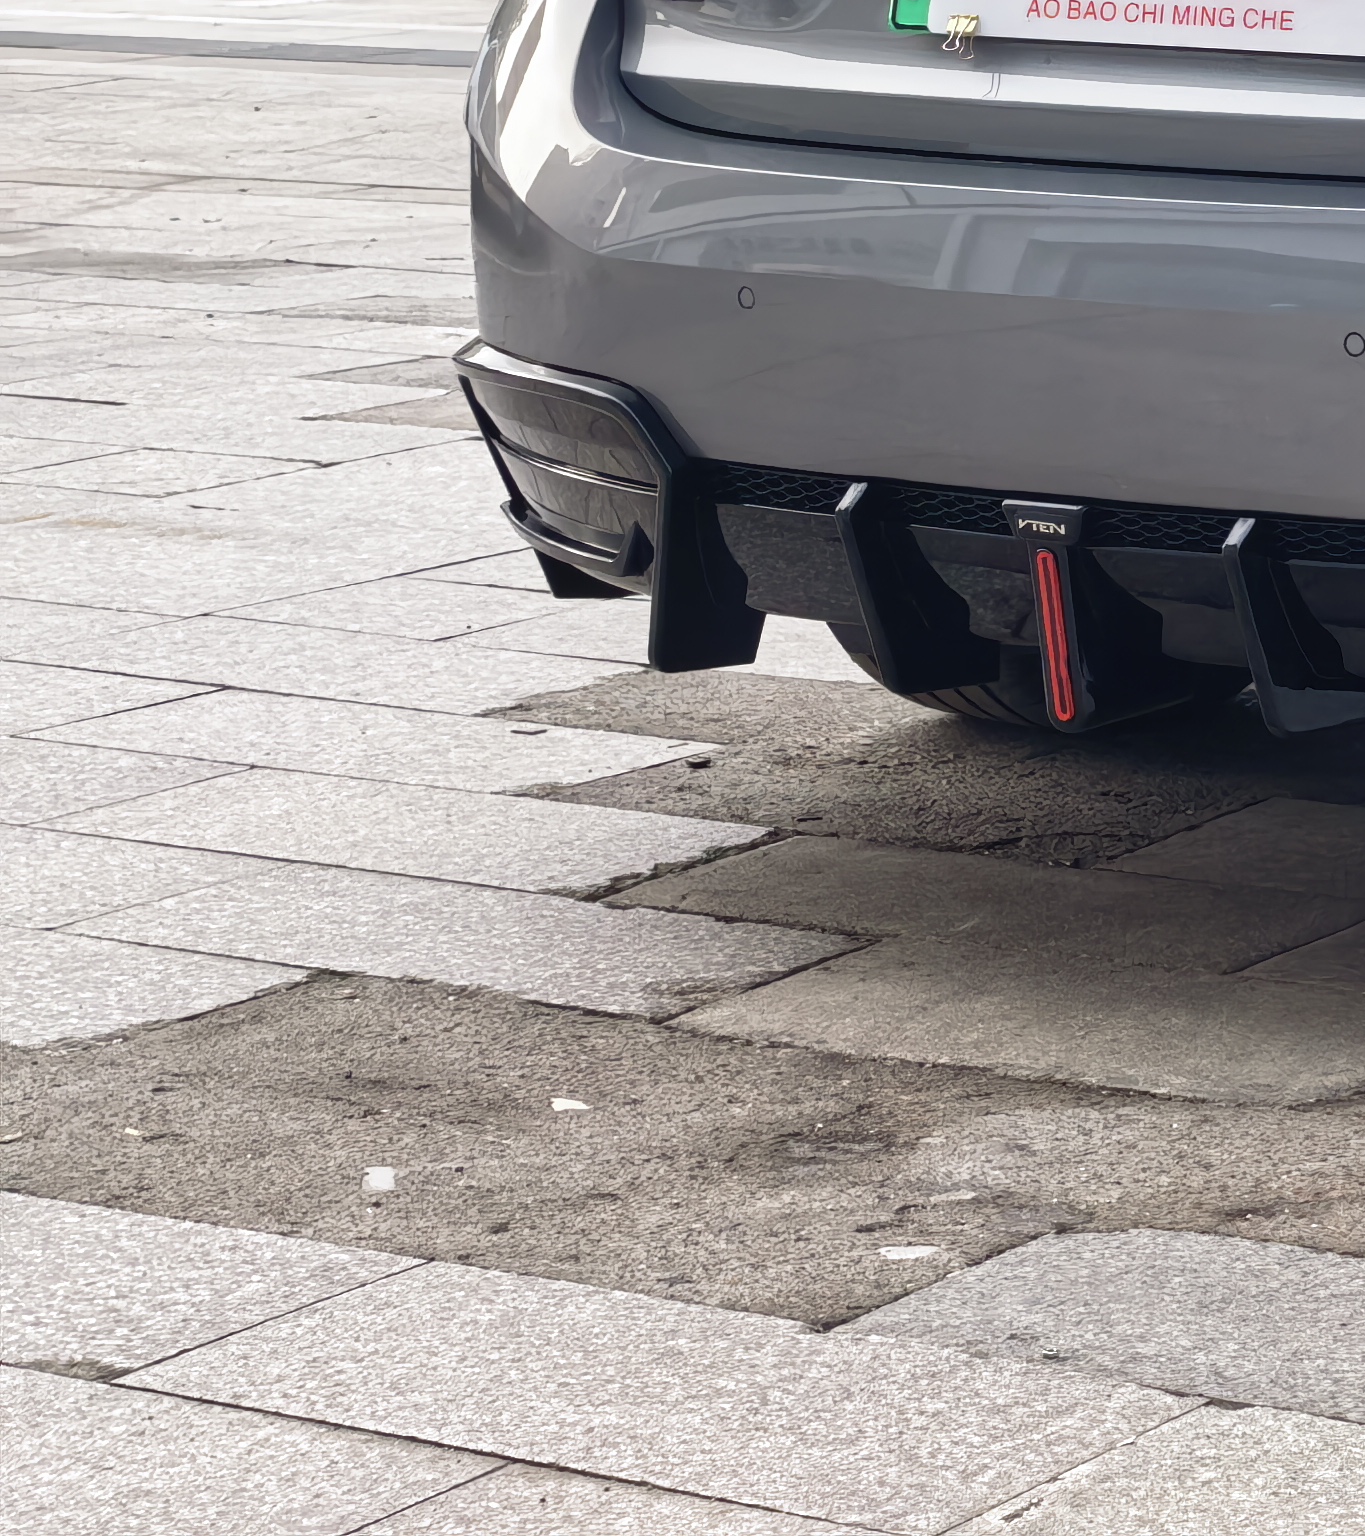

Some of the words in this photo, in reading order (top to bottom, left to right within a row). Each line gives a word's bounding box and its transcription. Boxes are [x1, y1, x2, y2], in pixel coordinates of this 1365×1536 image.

[1067, 0, 1116, 22] BAO
[1124, 2, 1164, 25] CHI
[1172, 5, 1235, 29] MING
[1243, 8, 1295, 32] CHE
